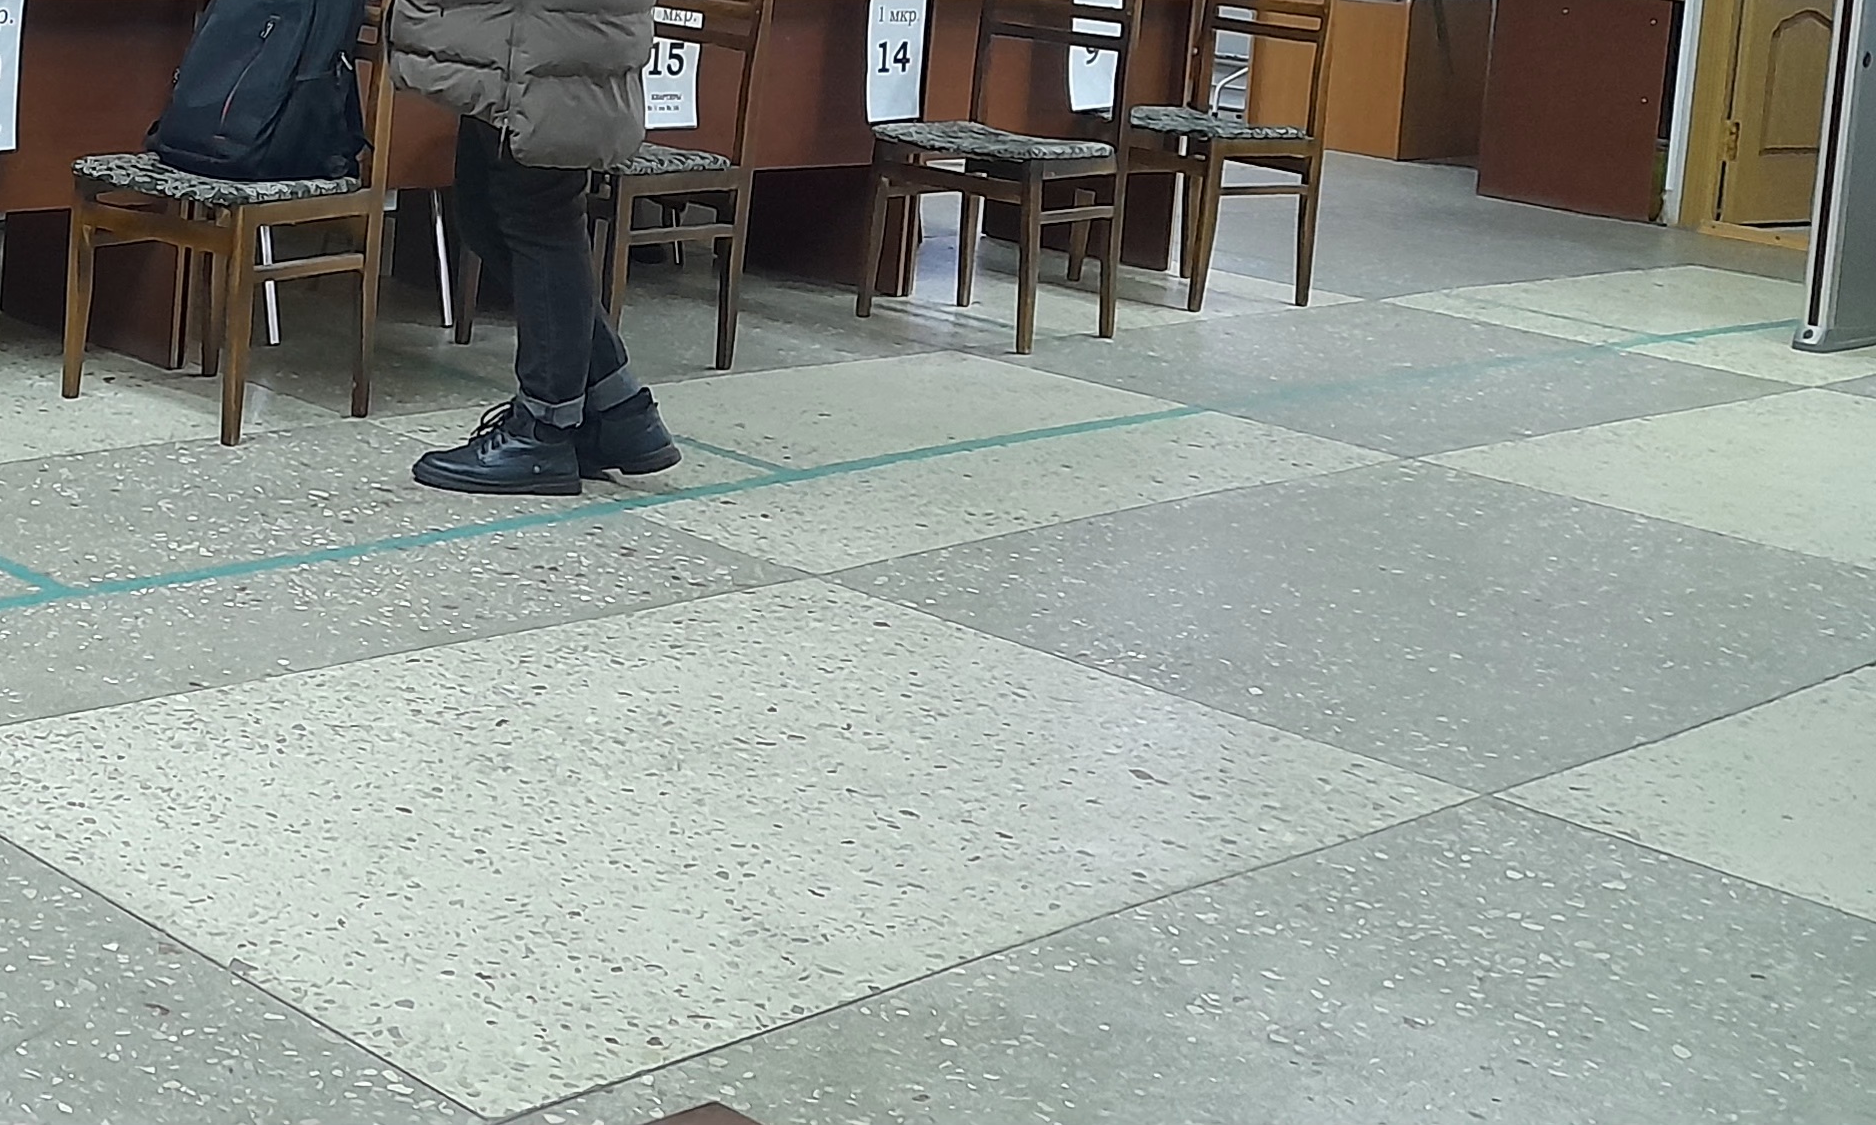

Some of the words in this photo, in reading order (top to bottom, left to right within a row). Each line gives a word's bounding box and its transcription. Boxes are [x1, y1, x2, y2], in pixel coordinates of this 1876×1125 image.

[879, 6, 884, 22] 1
[890, 10, 919, 26] мкр.
[648, 41, 684, 76] 15
[878, 41, 910, 73] 14
